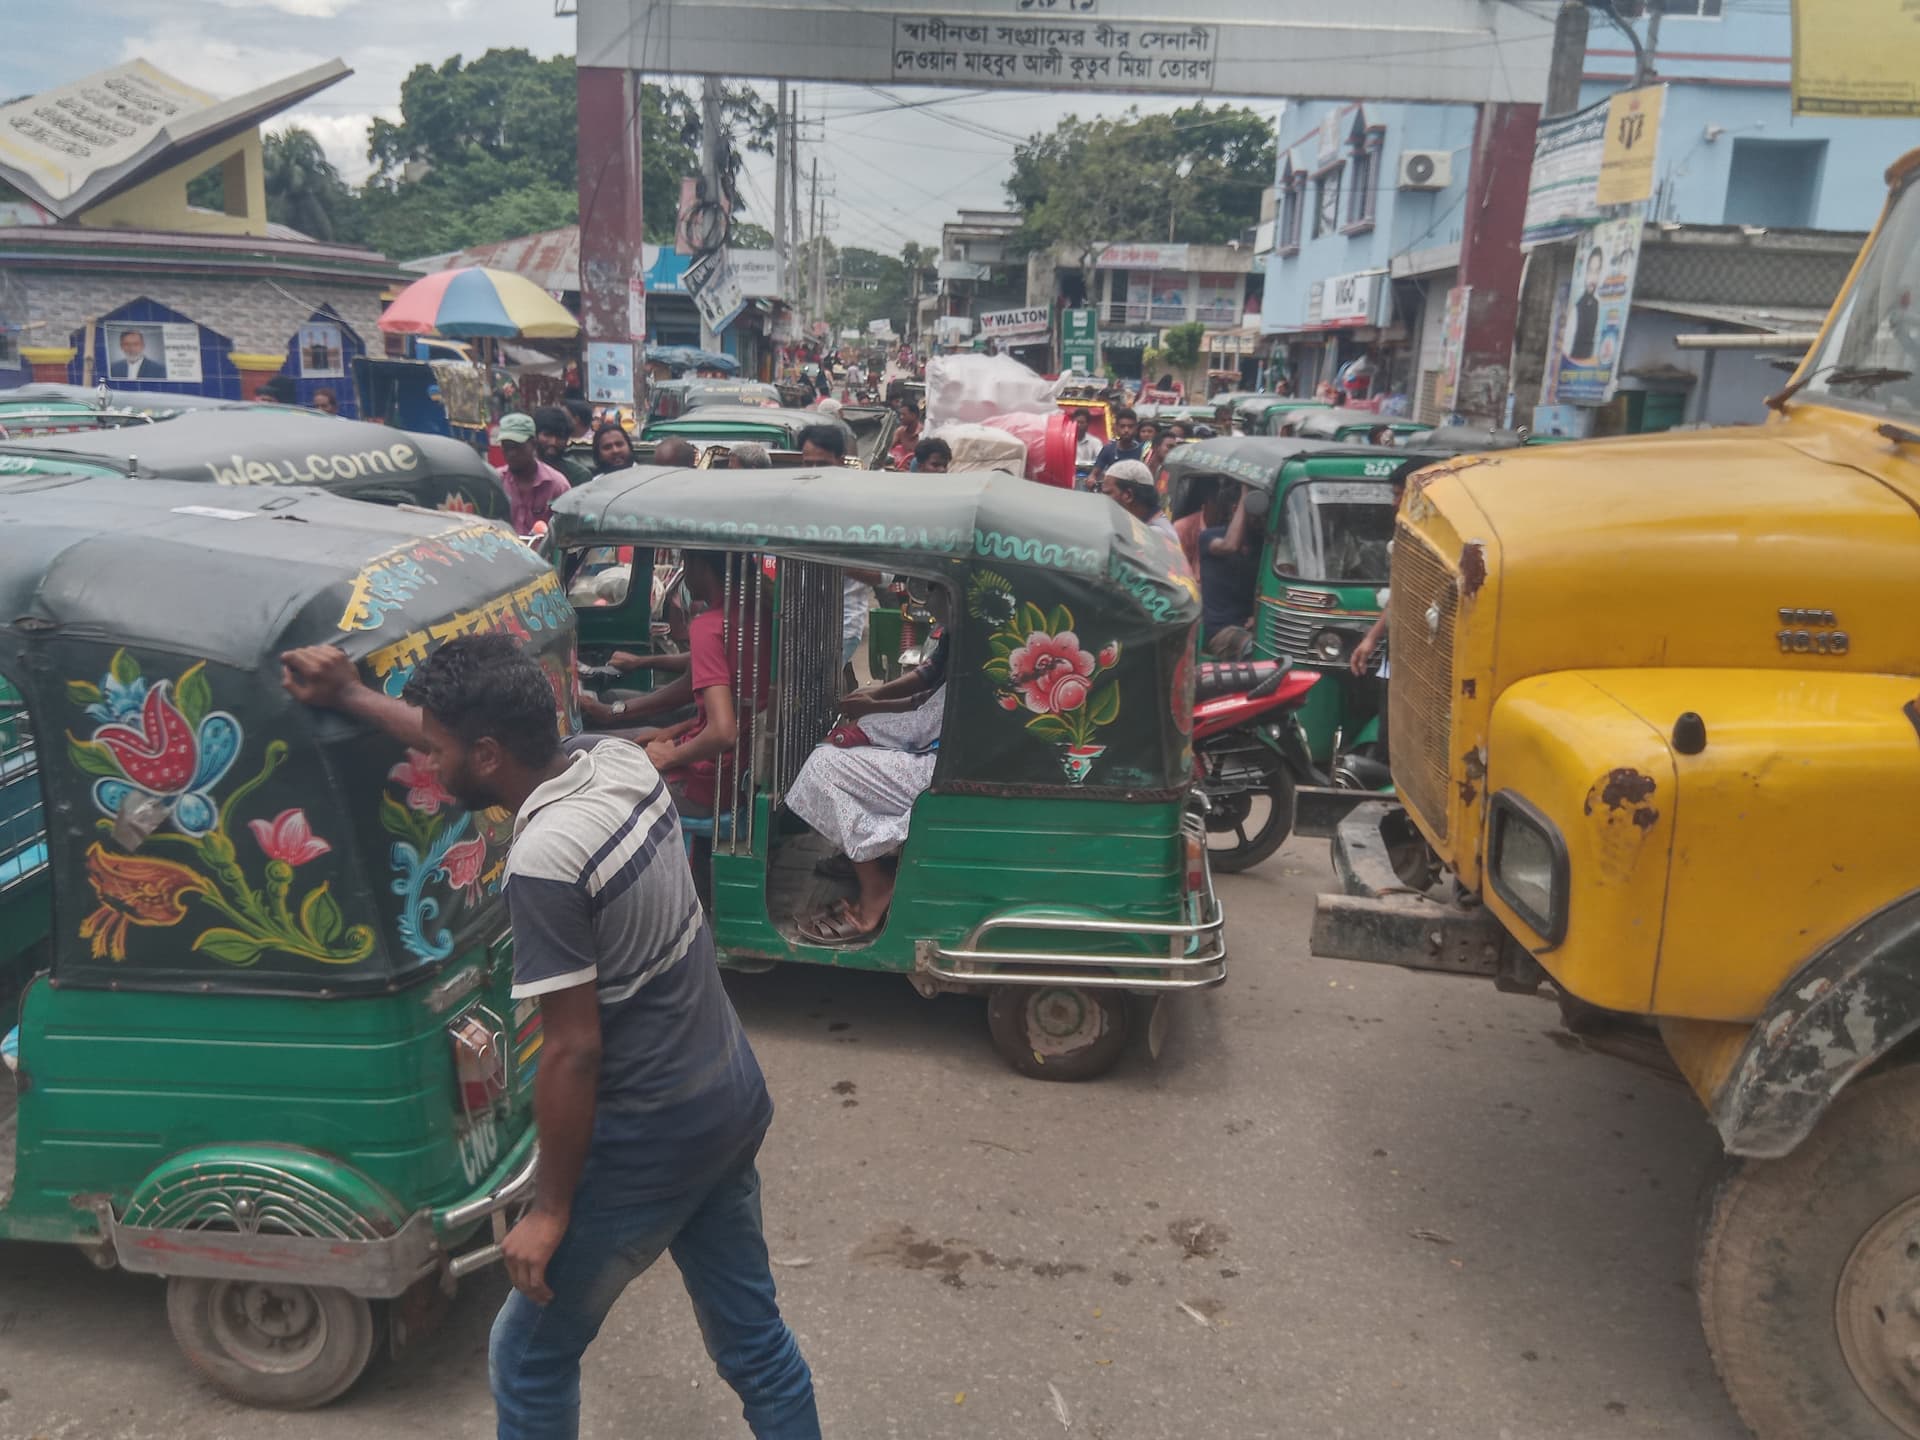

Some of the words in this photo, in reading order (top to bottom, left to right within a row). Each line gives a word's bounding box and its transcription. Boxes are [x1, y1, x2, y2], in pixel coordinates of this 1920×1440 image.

[902, 18, 989, 45] স্বাধীনতা
[995, 24, 1086, 47] সংগ্রামের
[1095, 24, 1130, 48] বীর
[1140, 26, 1210, 51] সেনানী
[895, 49, 958, 72] দেওয়ান
[963, 52, 1018, 79] মাহবুব
[1023, 47, 1064, 76] আলী
[1117, 50, 1152, 80] মিয়া
[1158, 57, 1211, 81] তোরণ
[995, 309, 1047, 327] WALTON
